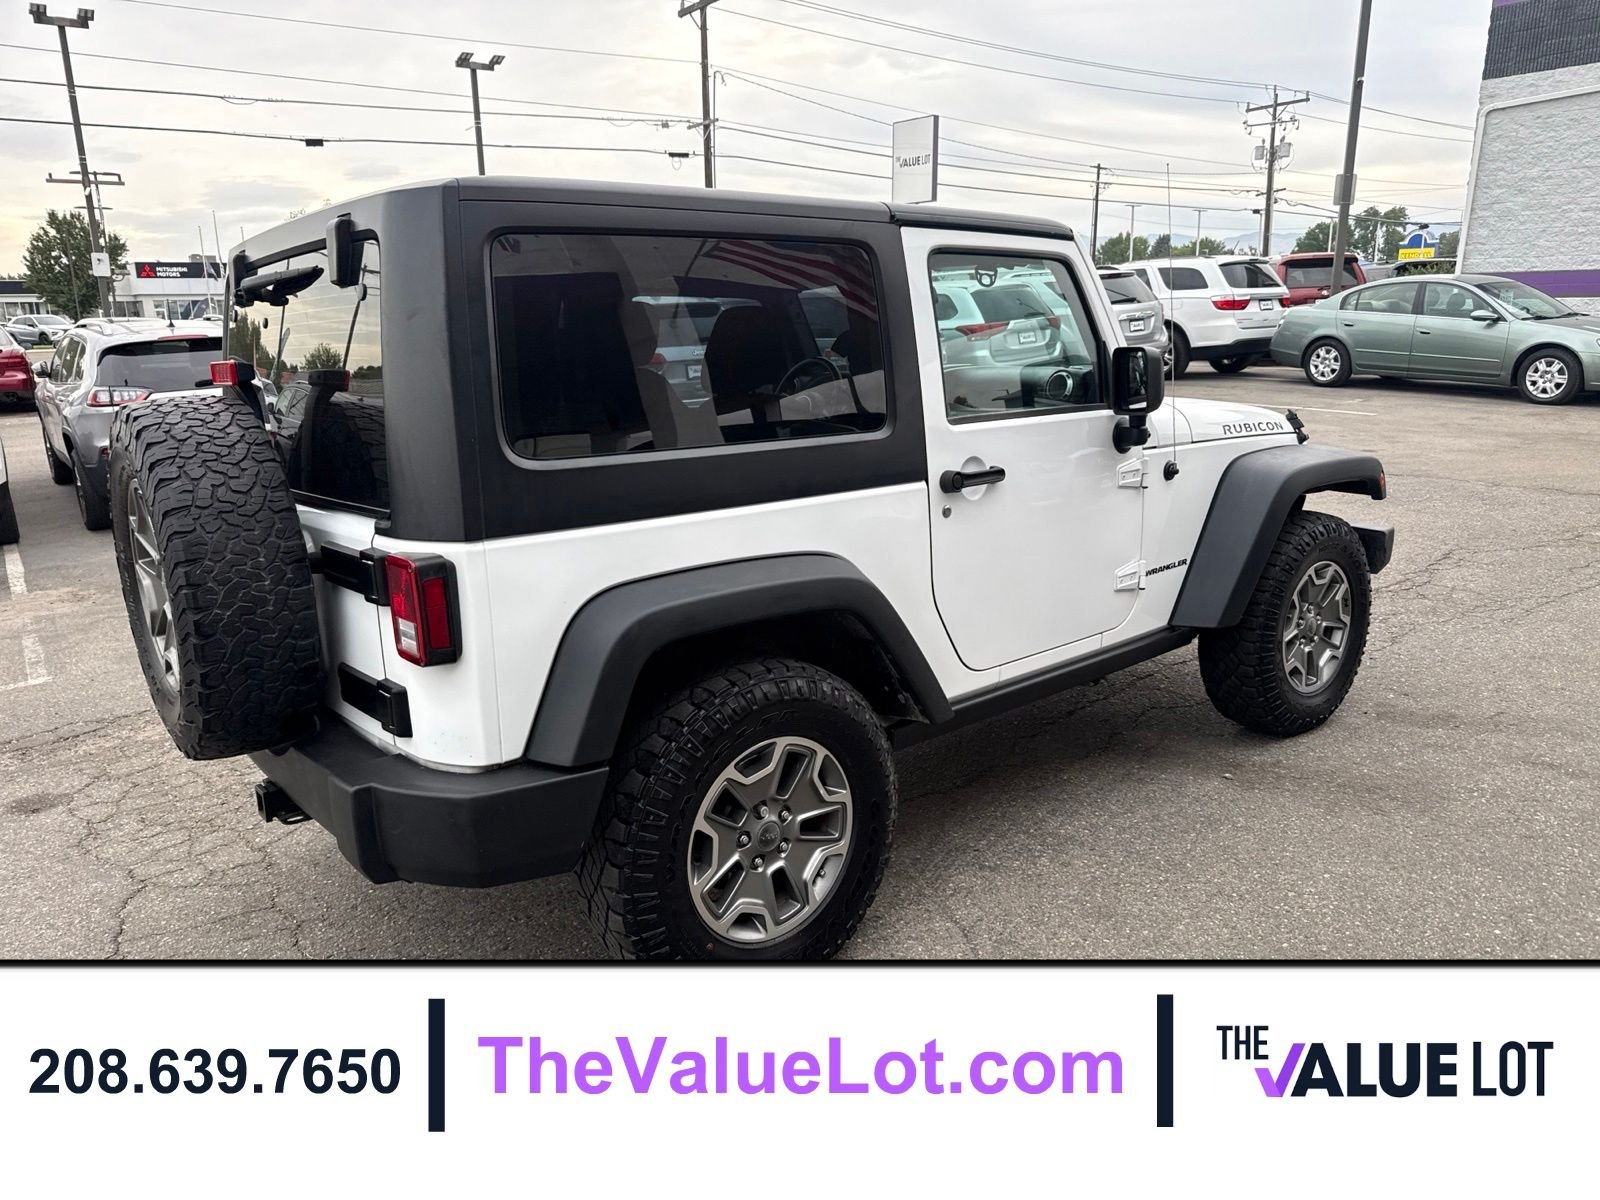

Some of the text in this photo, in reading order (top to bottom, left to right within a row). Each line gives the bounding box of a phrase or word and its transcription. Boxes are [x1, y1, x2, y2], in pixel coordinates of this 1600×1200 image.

[899, 156, 921, 168] VALUE
[1222, 421, 1284, 435] RUBICON
[1145, 558, 1188, 577] WRANGLER
